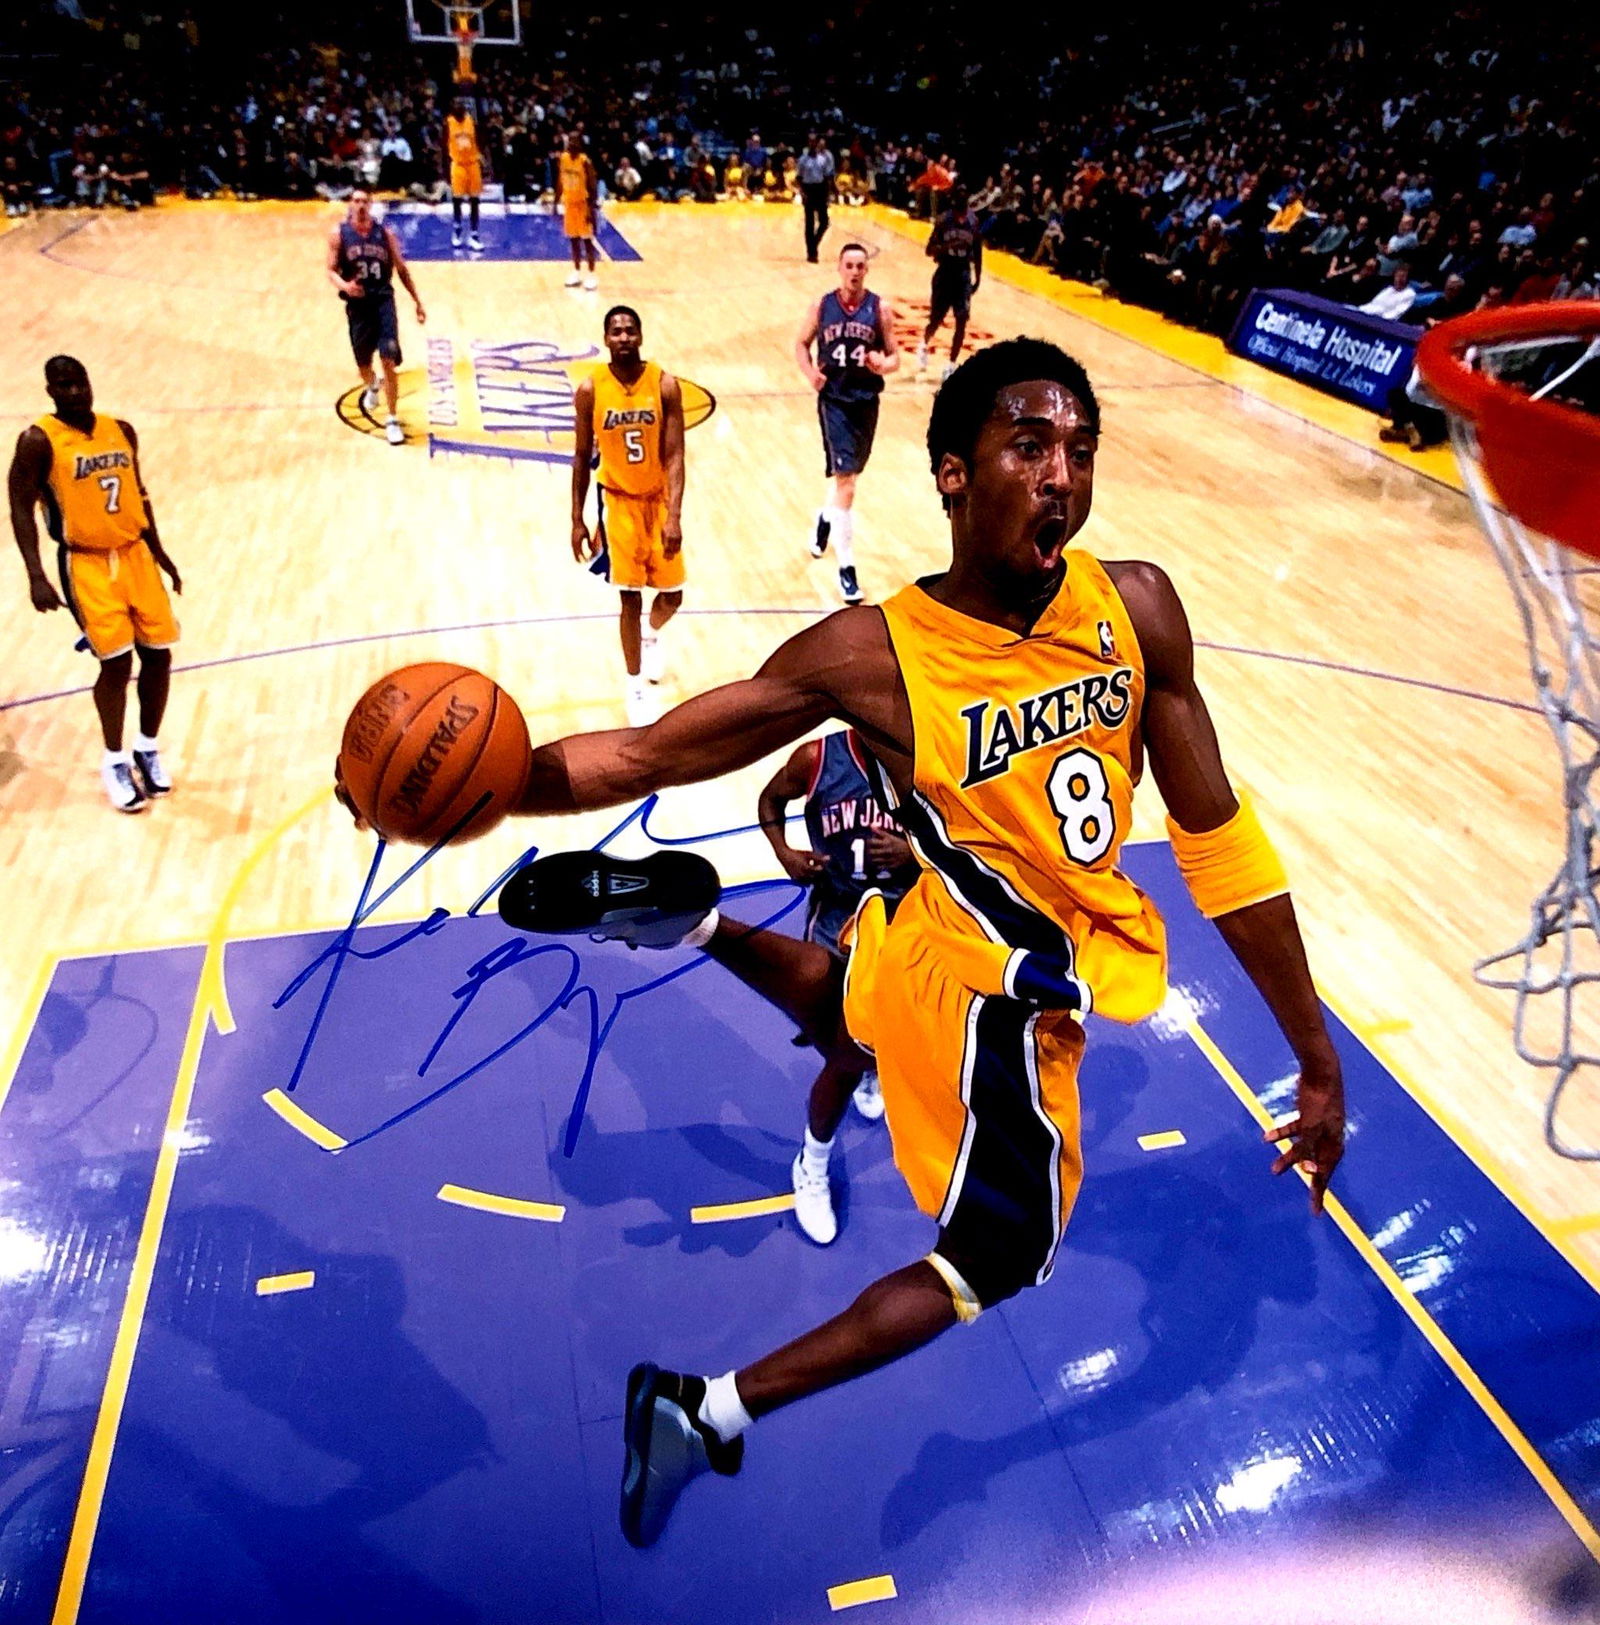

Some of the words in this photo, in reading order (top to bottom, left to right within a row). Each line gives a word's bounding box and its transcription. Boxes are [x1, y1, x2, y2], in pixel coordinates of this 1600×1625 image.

[356, 261, 382, 280] 34
[832, 343, 867, 368] 44
[1255, 302, 1327, 349] Centinela
[1323, 325, 1402, 376] Hospital
[603, 409, 656, 430] LAKERS
[74, 452, 130, 480] LAKERS
[624, 430, 646, 465] 5
[98, 475, 122, 514] 7
[960, 667, 1133, 789] LAKERS
[389, 695, 480, 815] SPALDING
[821, 799, 858, 838] NEW
[1044, 746, 1117, 867] 8
